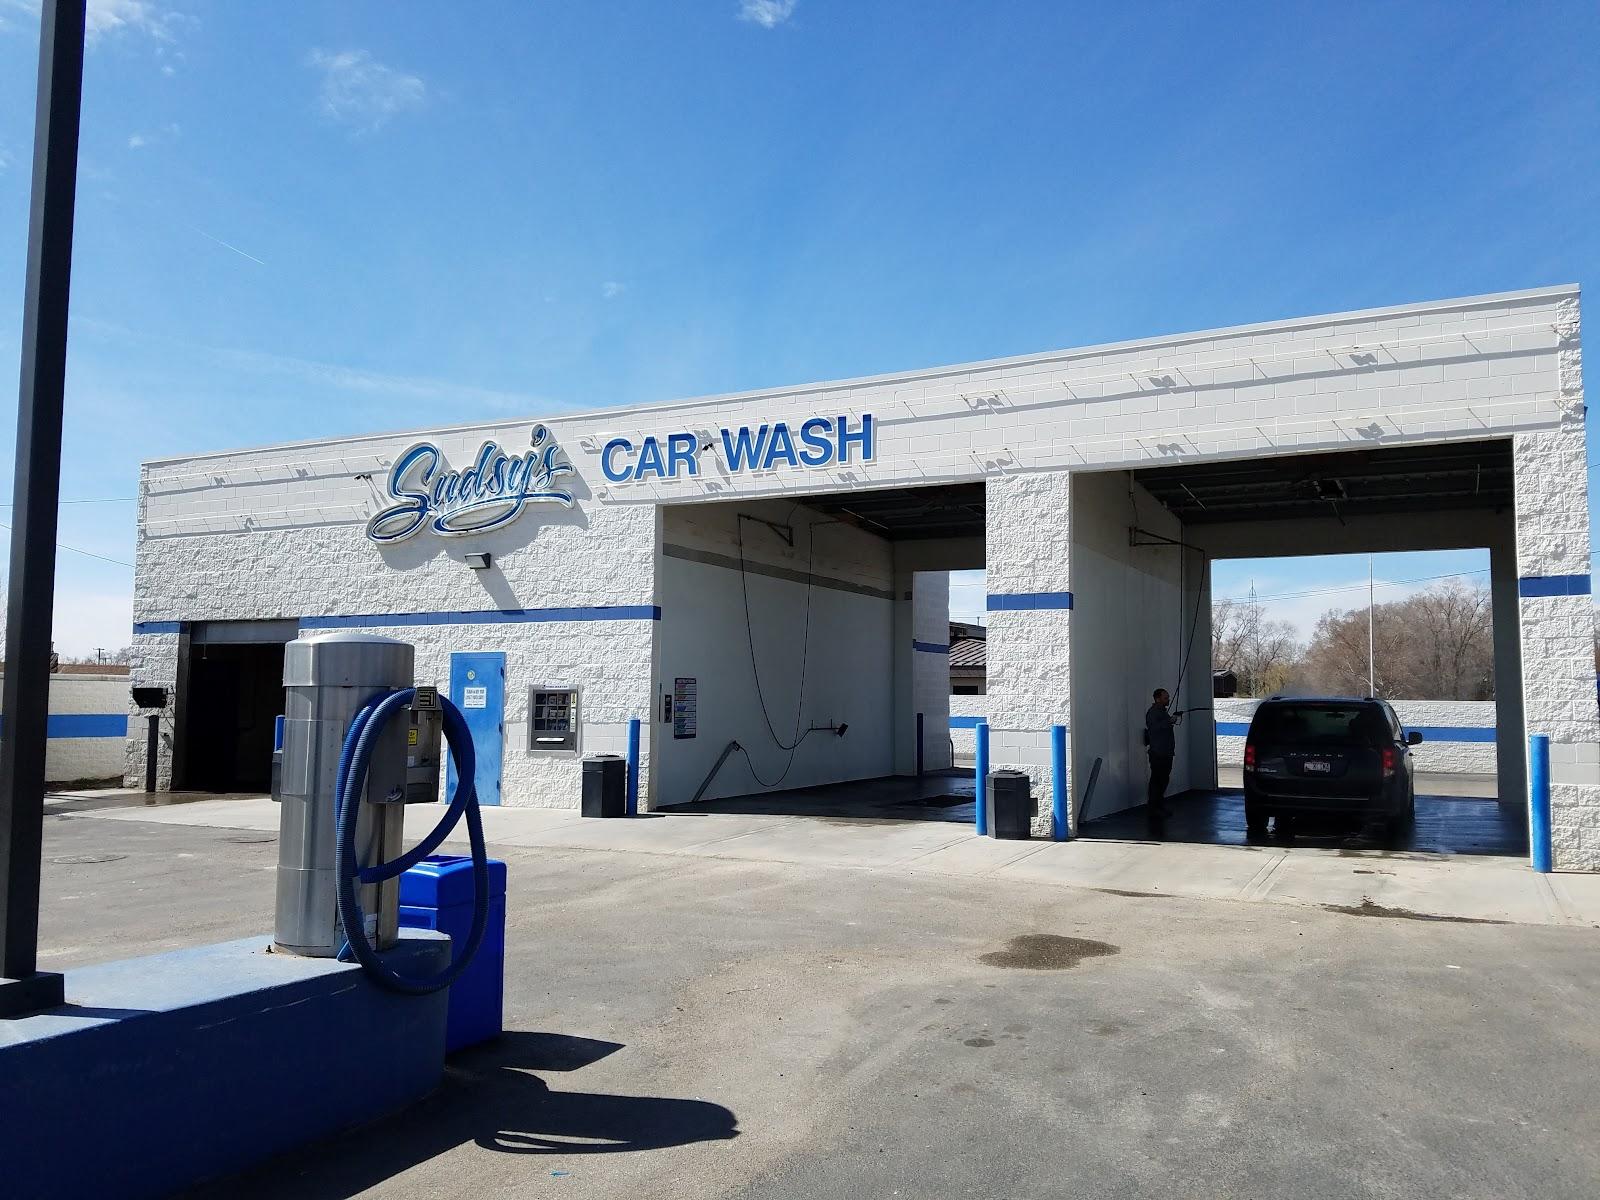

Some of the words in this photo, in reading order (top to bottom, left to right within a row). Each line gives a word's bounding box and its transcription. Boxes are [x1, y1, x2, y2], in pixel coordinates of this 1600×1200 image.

[368, 425, 575, 543] Sudsy's
[601, 432, 699, 483] CAR
[720, 413, 873, 472] WASH
